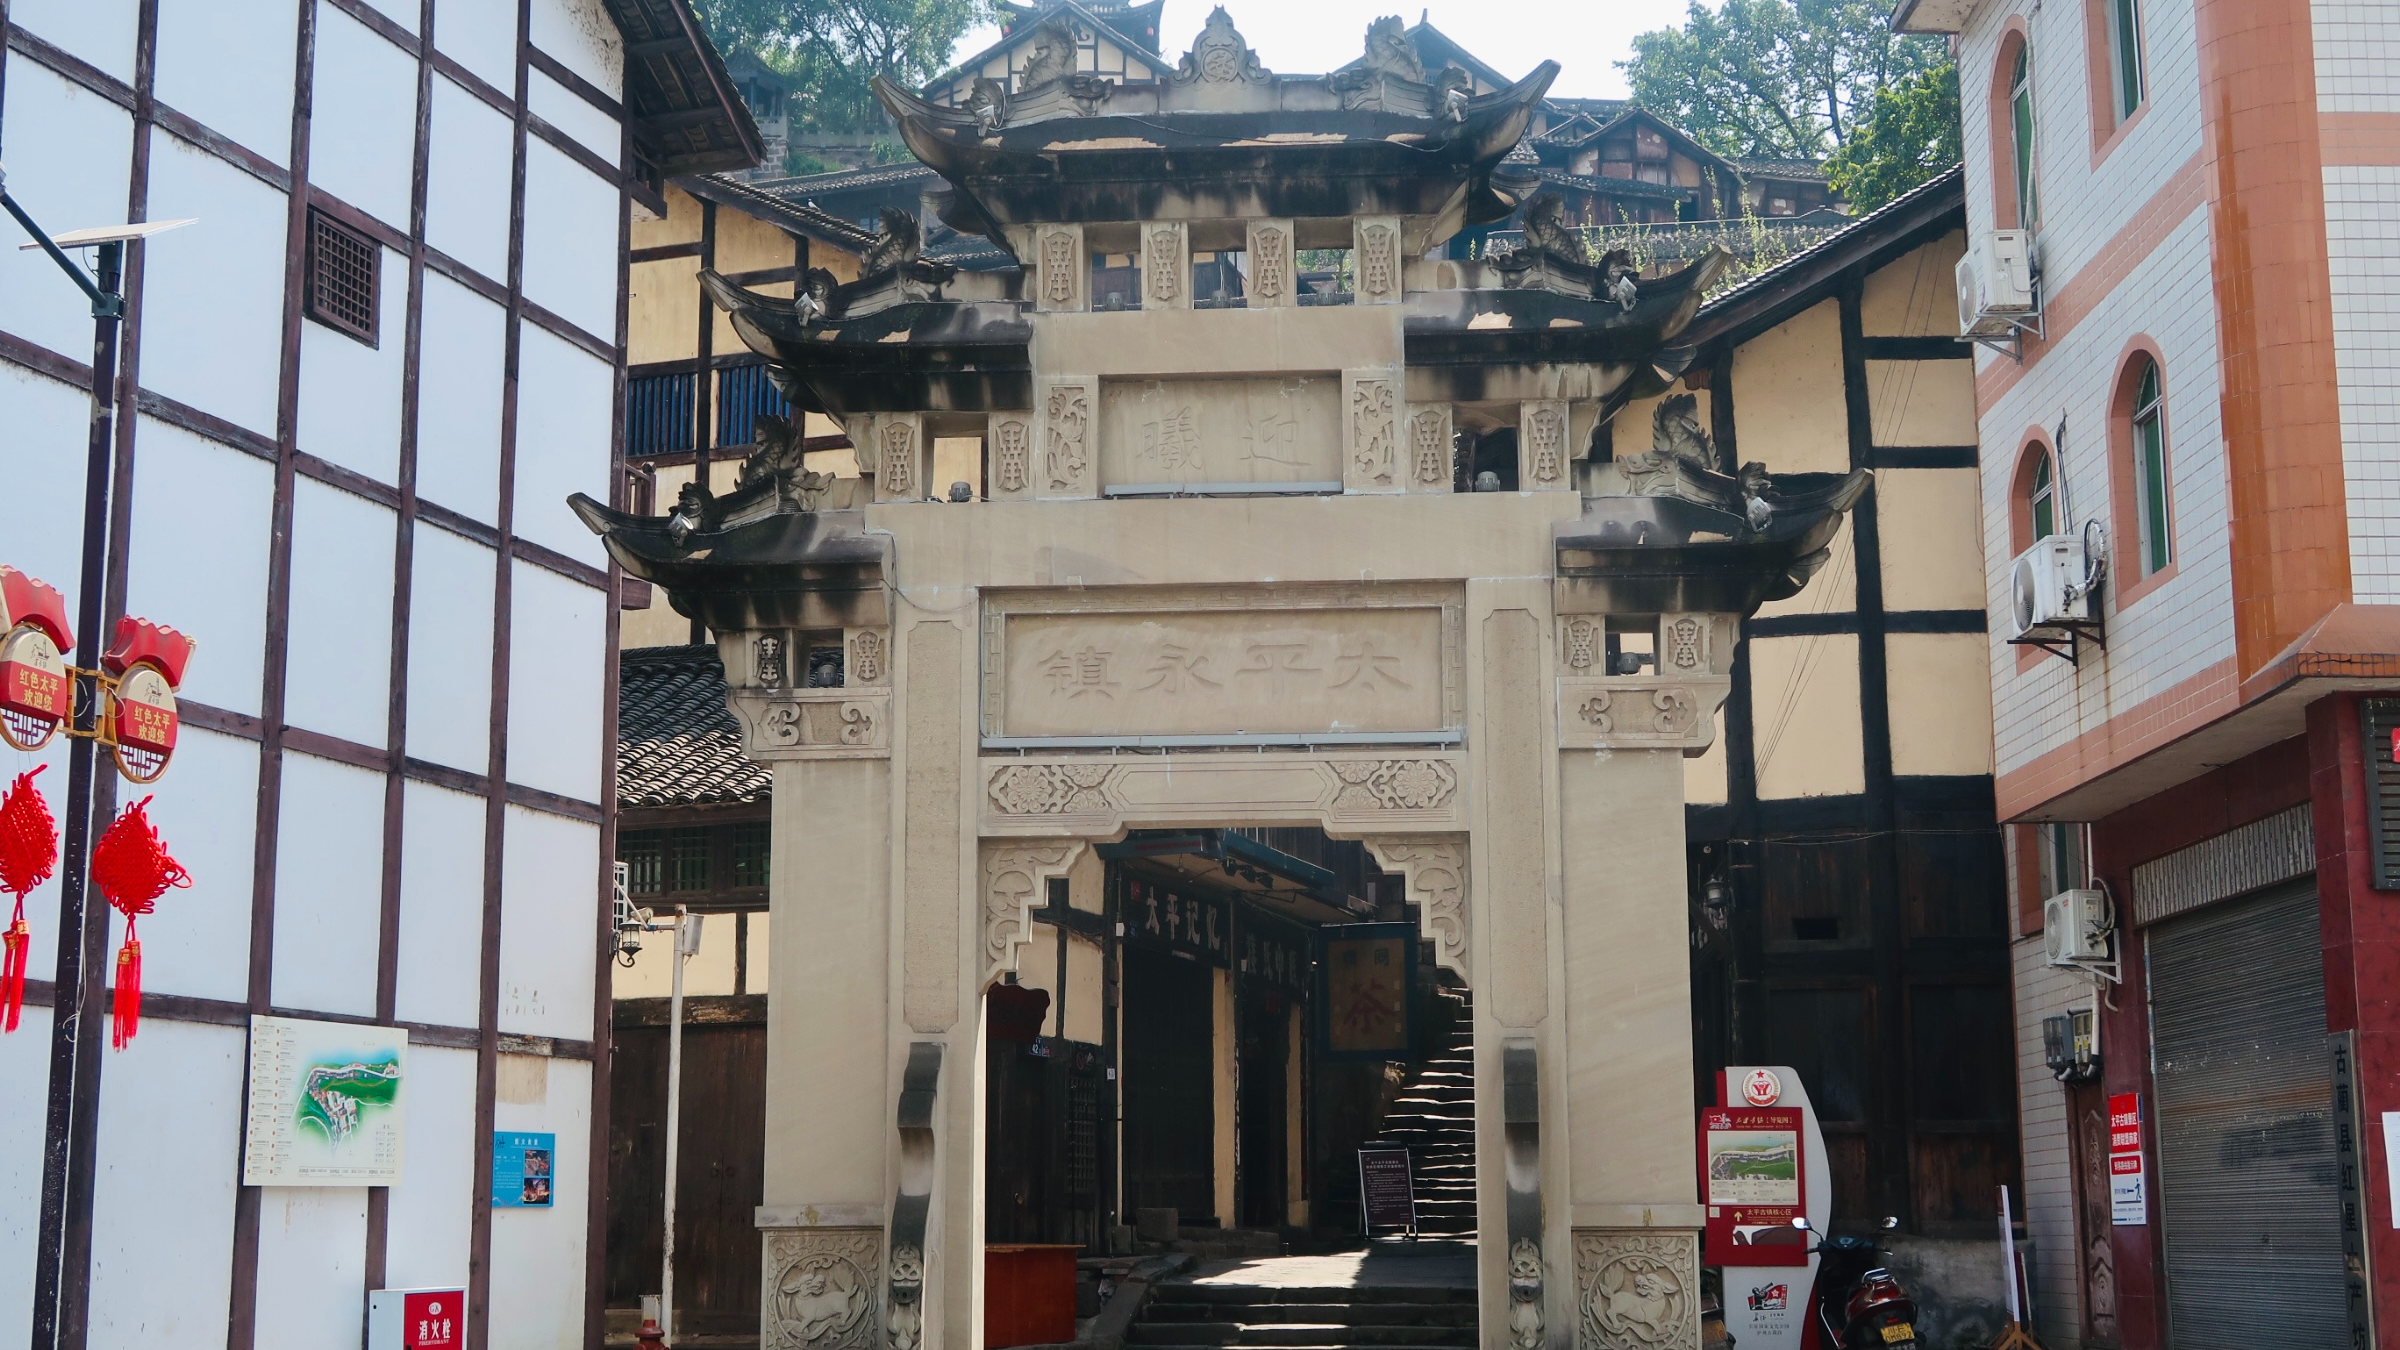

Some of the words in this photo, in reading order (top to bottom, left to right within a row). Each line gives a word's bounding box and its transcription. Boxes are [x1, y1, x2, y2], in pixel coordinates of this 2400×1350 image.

[19, 668, 58, 695] 红色太平
[23, 688, 52, 711] 欢迎您
[134, 705, 170, 730] 红色太平
[138, 723, 165, 744] 欢迎您
[1144, 885, 1220, 951] 太平记忆
[1746, 1208, 1792, 1216] 太平古镇核心区
[419, 1318, 451, 1340] 消火栓
